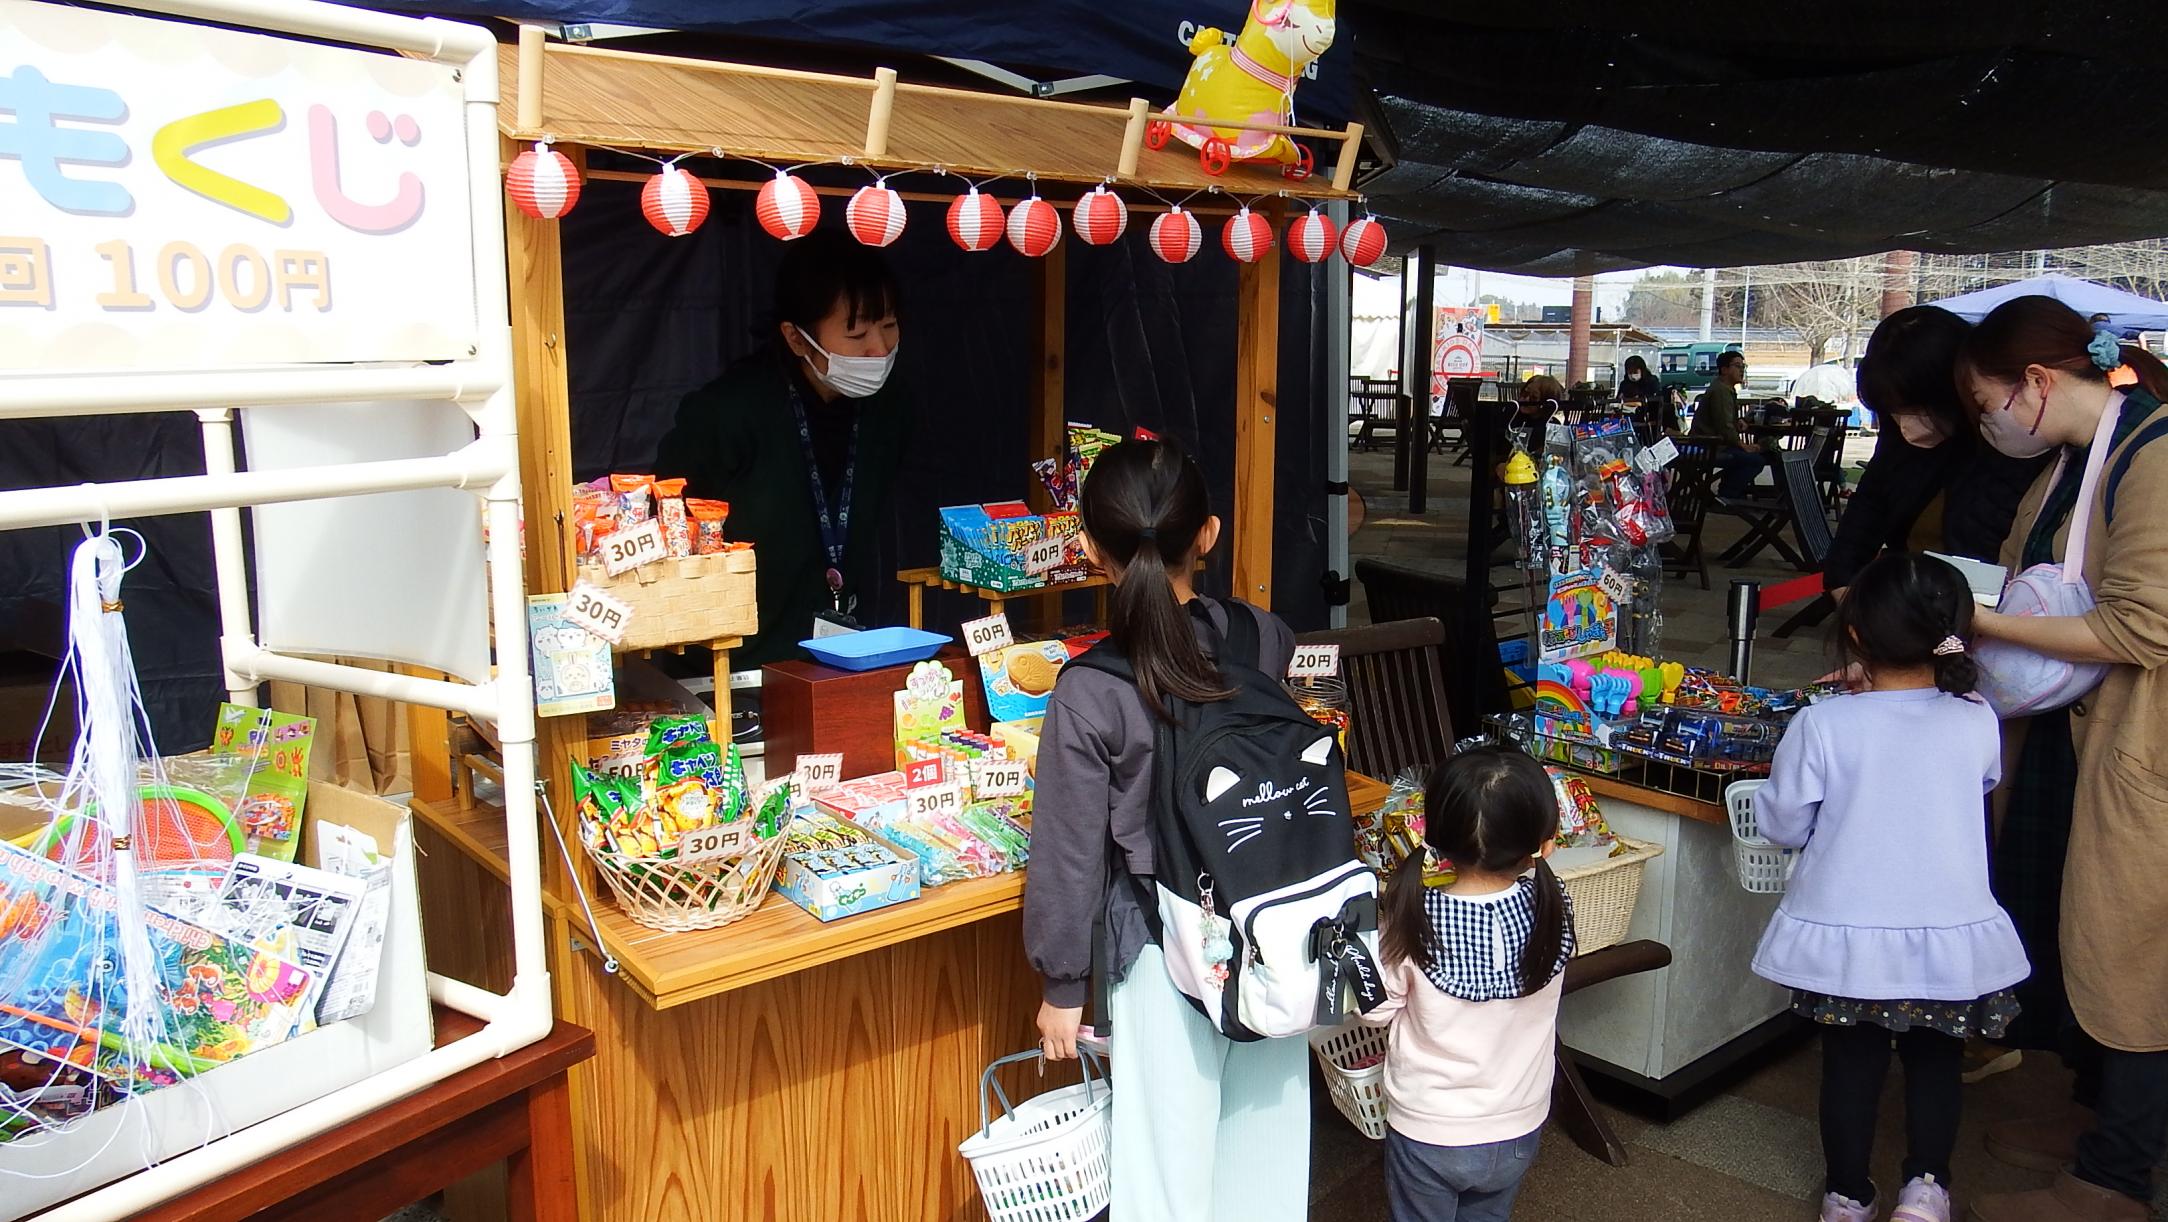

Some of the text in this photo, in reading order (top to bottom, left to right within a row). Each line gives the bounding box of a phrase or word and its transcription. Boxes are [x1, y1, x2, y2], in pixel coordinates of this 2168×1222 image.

[95, 238, 333, 312] 100円
[611, 533, 655, 562] 30円
[1032, 545, 1059, 564] 40円
[1603, 574, 1623, 596] 60円
[576, 594, 622, 630] 30円
[973, 623, 1005, 645] 60円
[1296, 654, 1331, 668] 20円
[671, 752, 716, 776] キャベツ
[911, 763, 939, 783] 2個
[985, 771, 1020, 787] 70円
[916, 792, 954, 813] 30円
[1242, 781, 1295, 808] mellow
[690, 831, 740, 854] 30円
